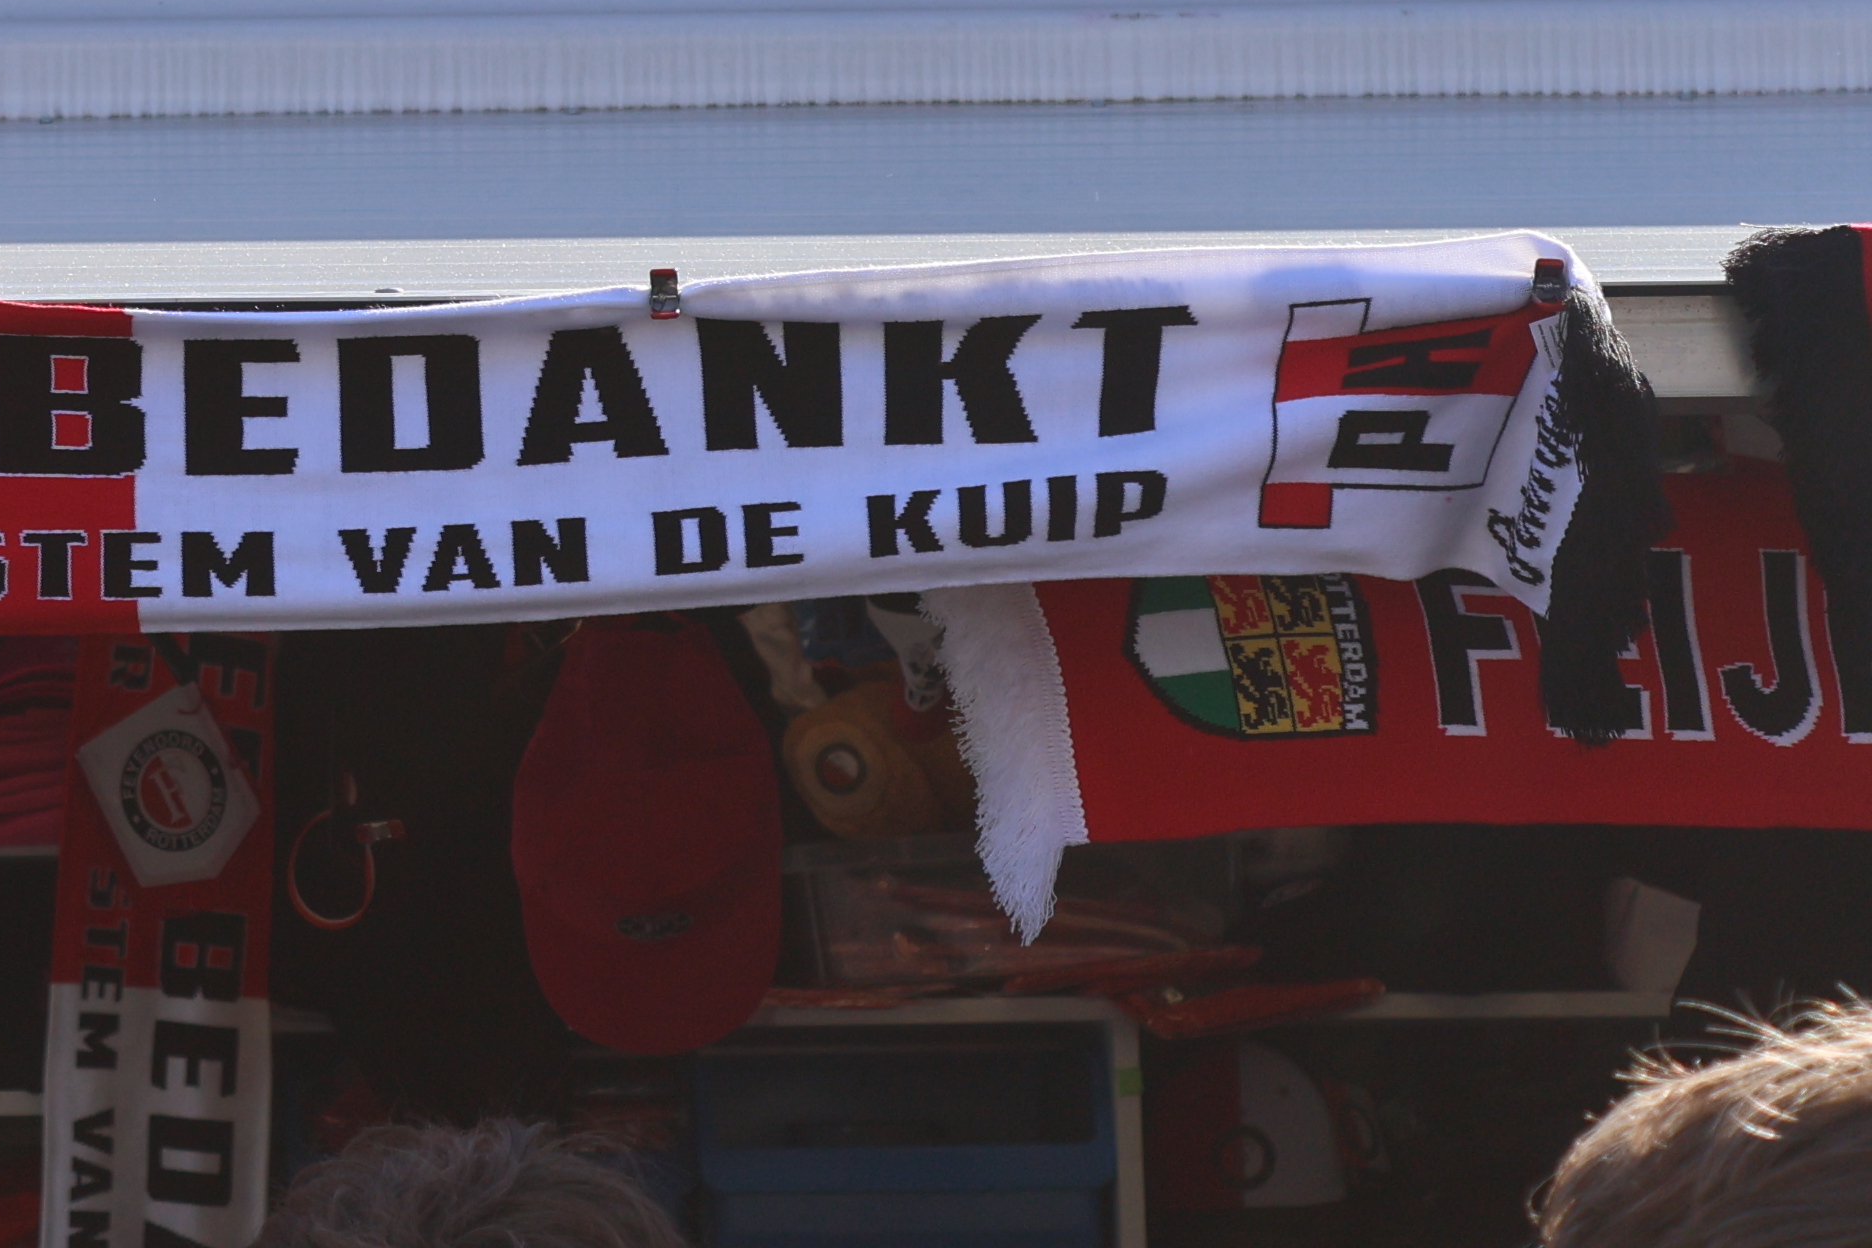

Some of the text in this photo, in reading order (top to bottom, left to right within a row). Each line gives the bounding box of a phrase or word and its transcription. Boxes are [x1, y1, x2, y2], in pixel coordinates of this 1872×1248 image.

[338, 516, 591, 594] VAN
[652, 500, 805, 577] DE
[866, 470, 1168, 558] KUIP
[1319, 572, 1370, 731] TTERDAM
[121, 731, 205, 800] FEYENOORD
[145, 786, 227, 851] ROTTERDAM
[144, 910, 249, 1248] BED
